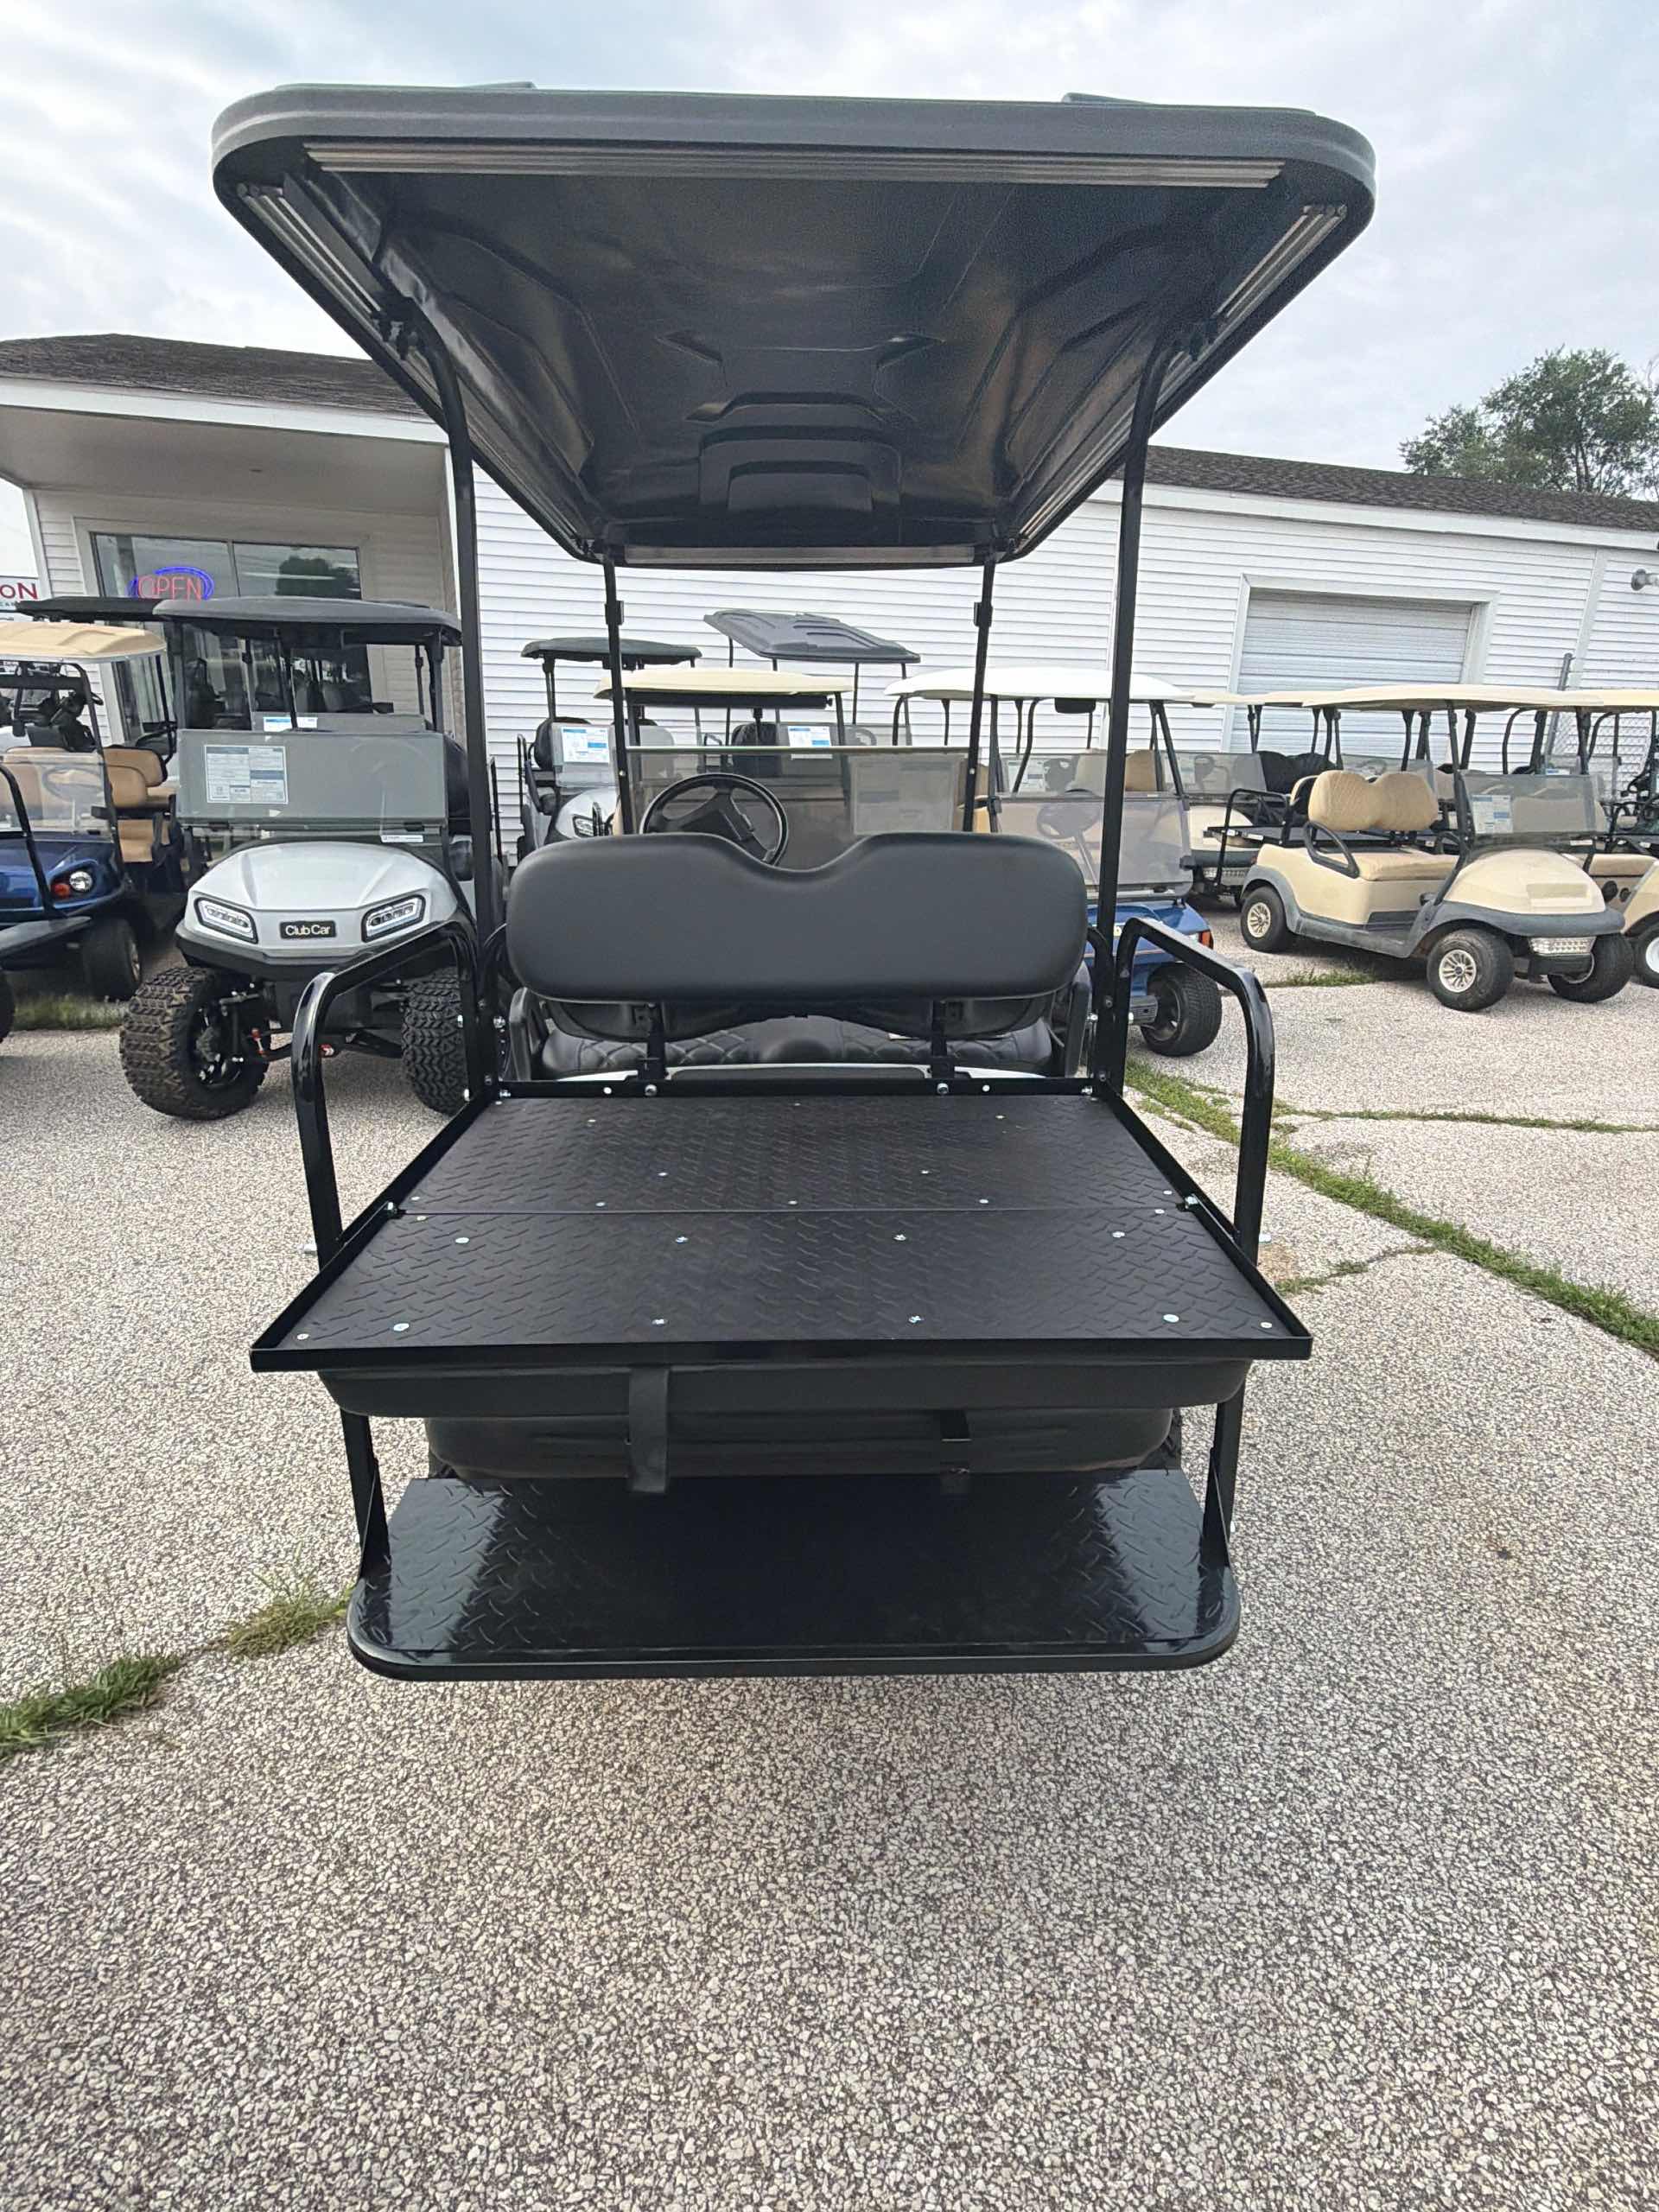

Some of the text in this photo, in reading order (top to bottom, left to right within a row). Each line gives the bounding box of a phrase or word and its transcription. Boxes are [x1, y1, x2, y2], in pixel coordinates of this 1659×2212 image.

[138, 575, 201, 601] OPEN
[285, 924, 330, 936] Club Car
